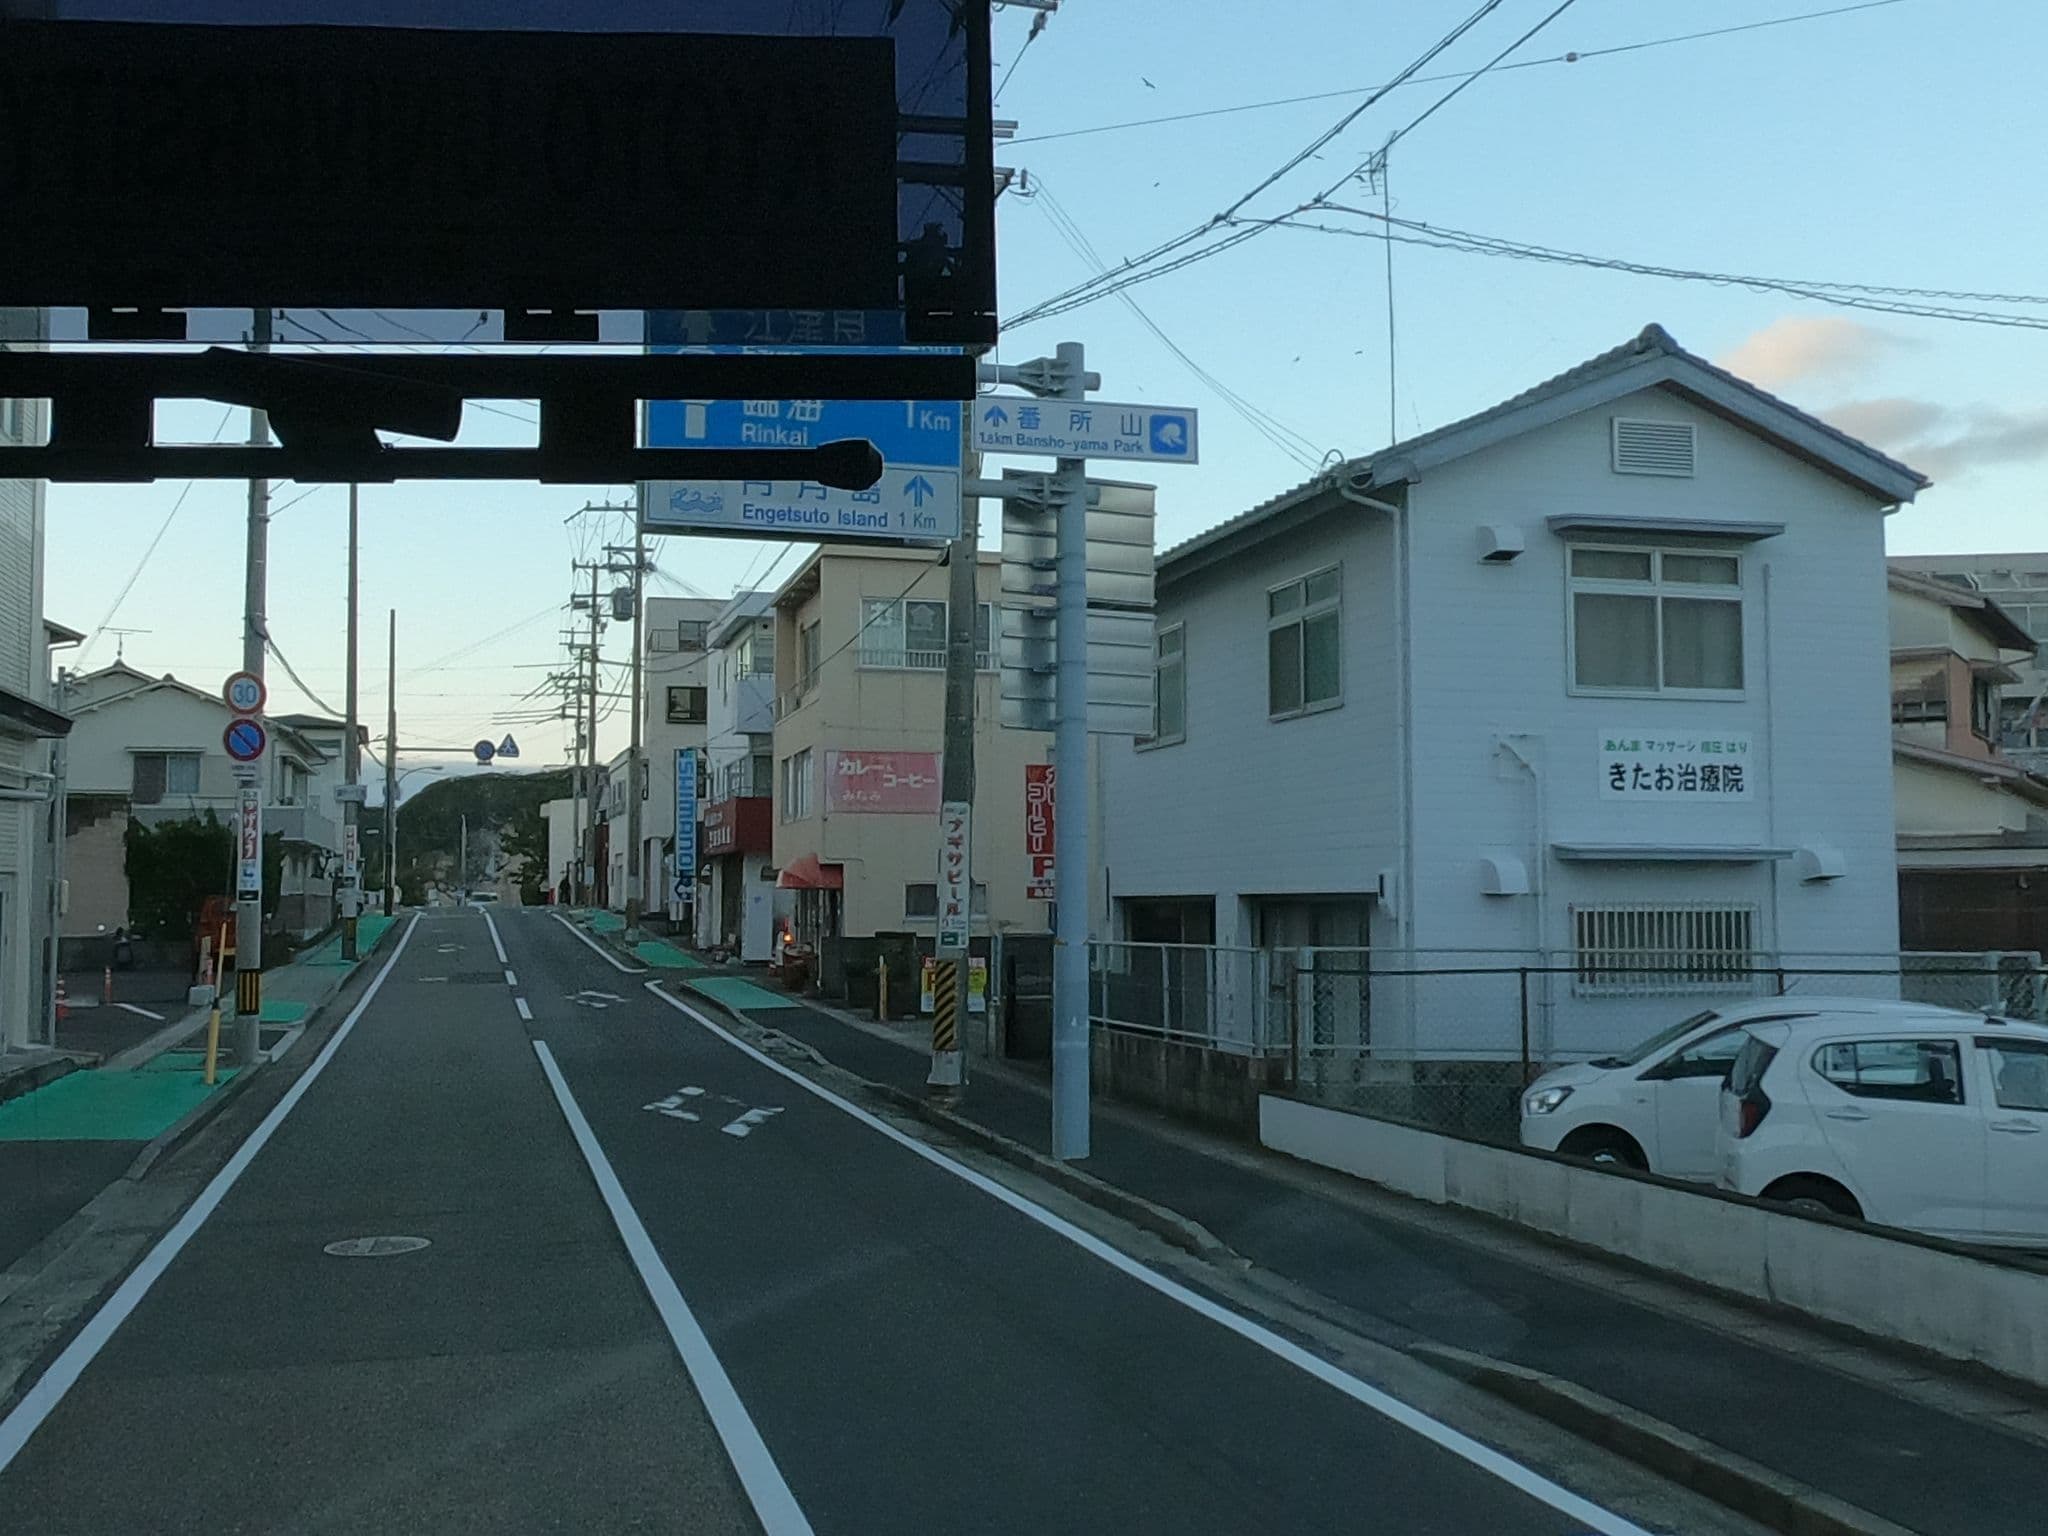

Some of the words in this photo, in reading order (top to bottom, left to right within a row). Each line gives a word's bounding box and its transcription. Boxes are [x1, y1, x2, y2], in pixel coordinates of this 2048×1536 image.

[919, 411, 951, 432] Km
[1015, 406, 1143, 437] 番所山
[741, 423, 808, 446] Rinkai
[1016, 433, 1107, 453] Bansho-yama
[1113, 439, 1144, 453] Park
[742, 504, 830, 528] Engetsuto
[838, 510, 889, 528] Island
[899, 513, 906, 527] 1
[914, 513, 937, 530] Km
[233, 684, 257, 704] 30
[883, 773, 936, 789] コーヒー
[1609, 762, 1743, 793] きたお治療院
